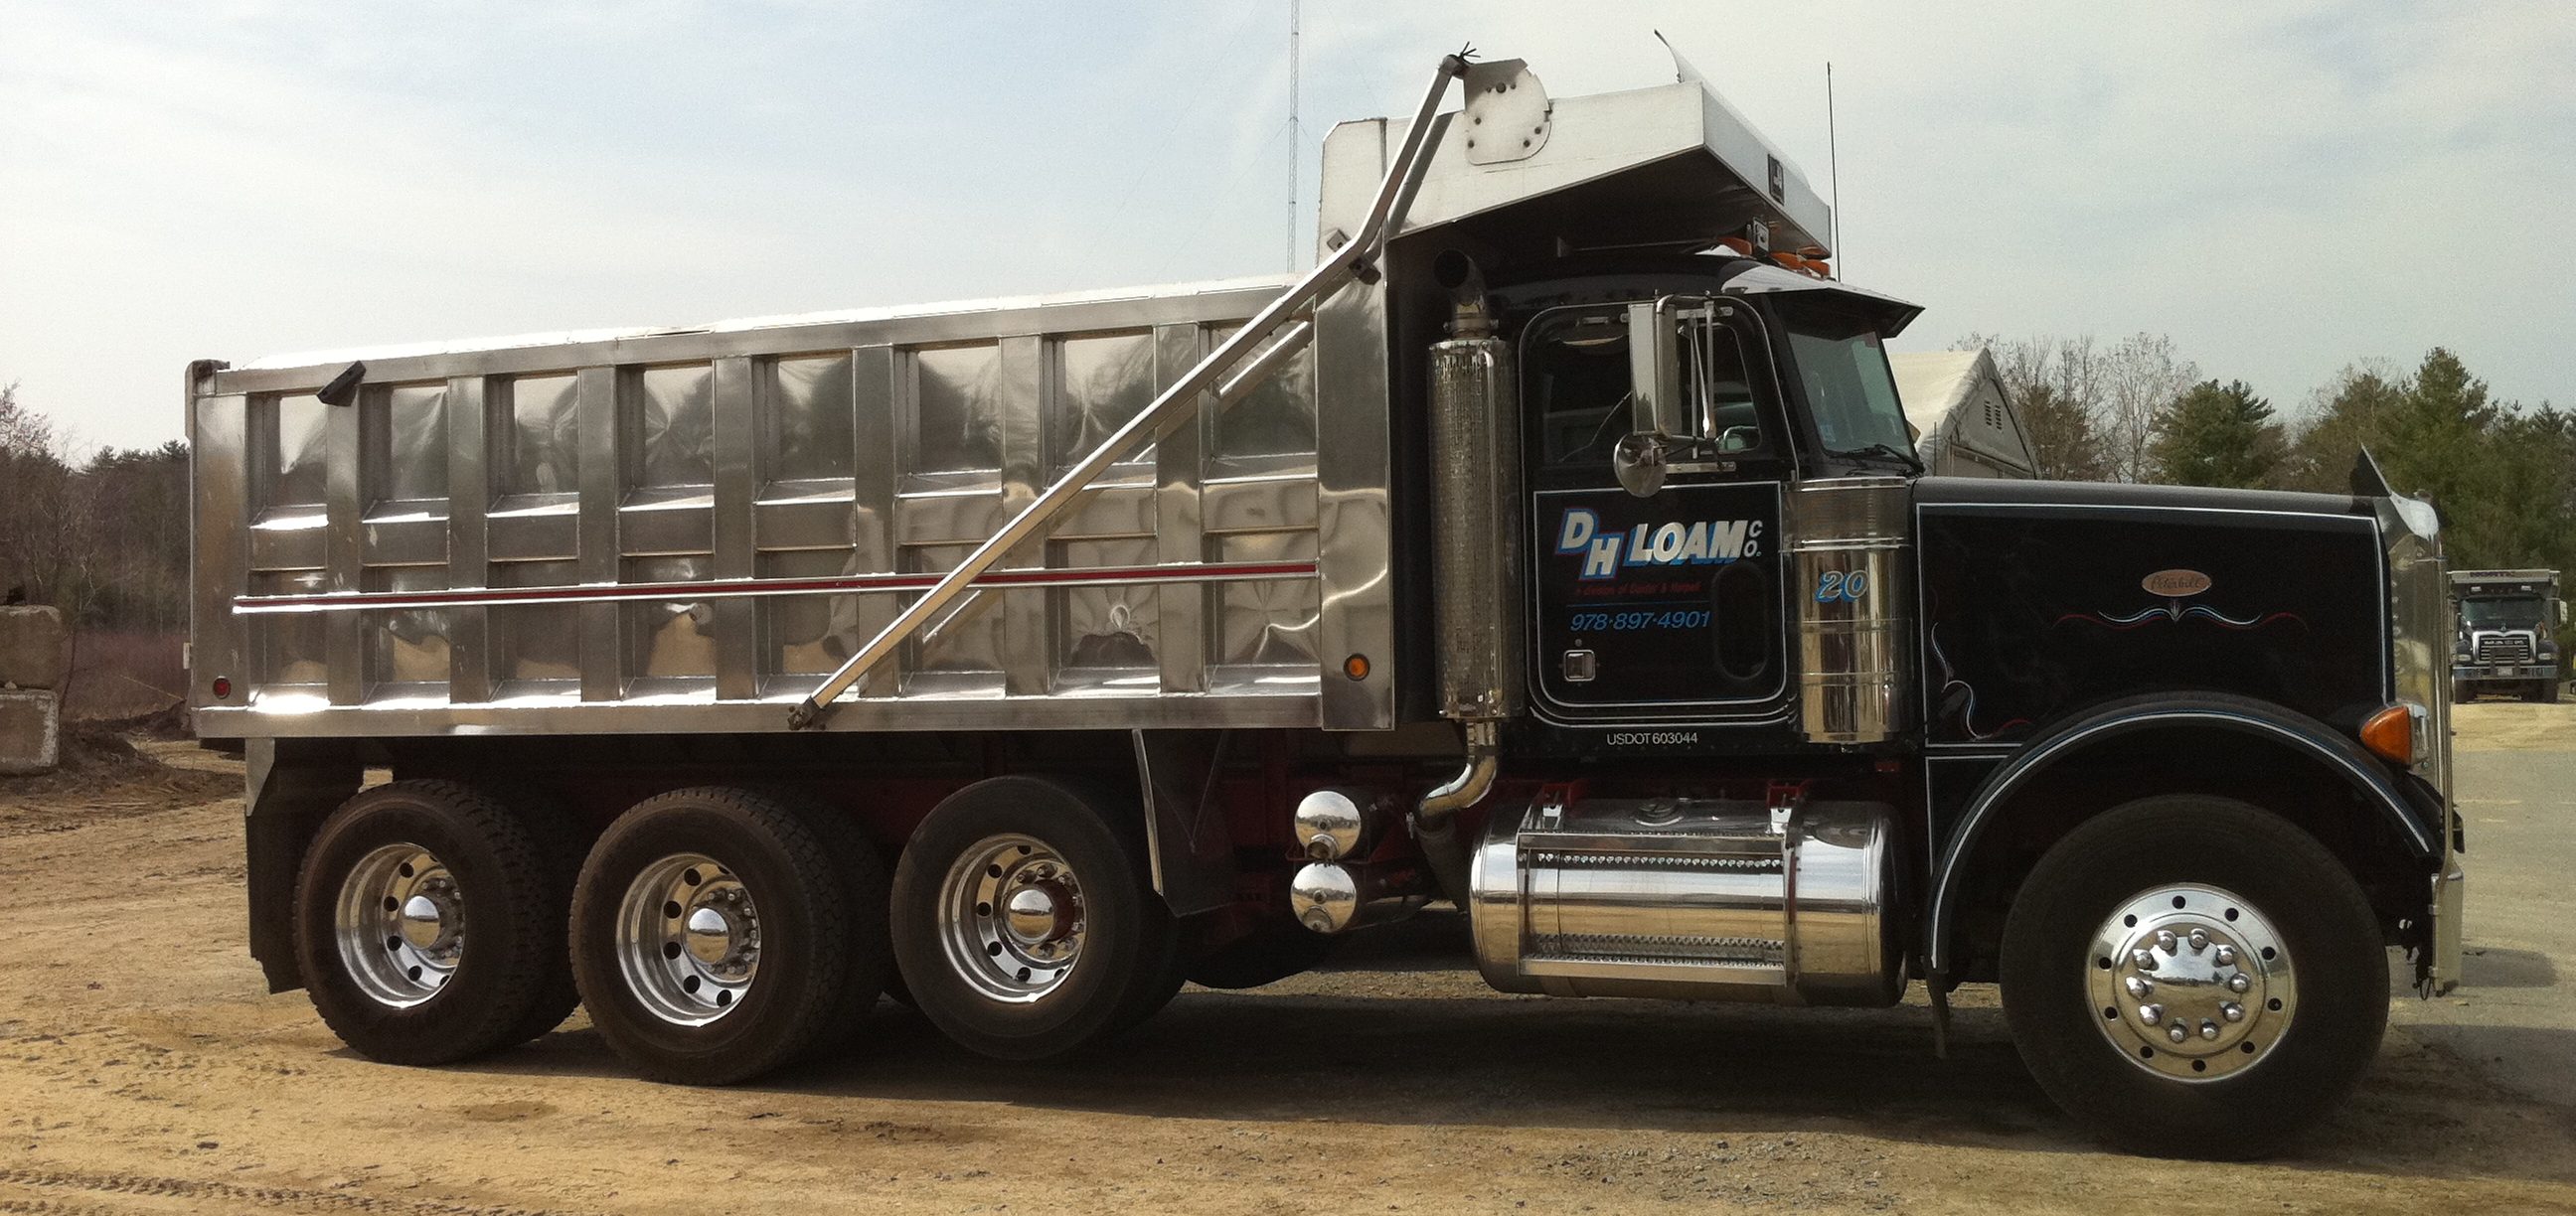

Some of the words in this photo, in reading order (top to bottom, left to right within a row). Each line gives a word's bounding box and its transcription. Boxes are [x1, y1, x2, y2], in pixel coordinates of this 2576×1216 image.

[1624, 520, 1749, 565] LOAM
[1815, 570, 1869, 602] 20
[1606, 732, 1651, 745] USDOT
[1652, 731, 1697, 745] 603044
